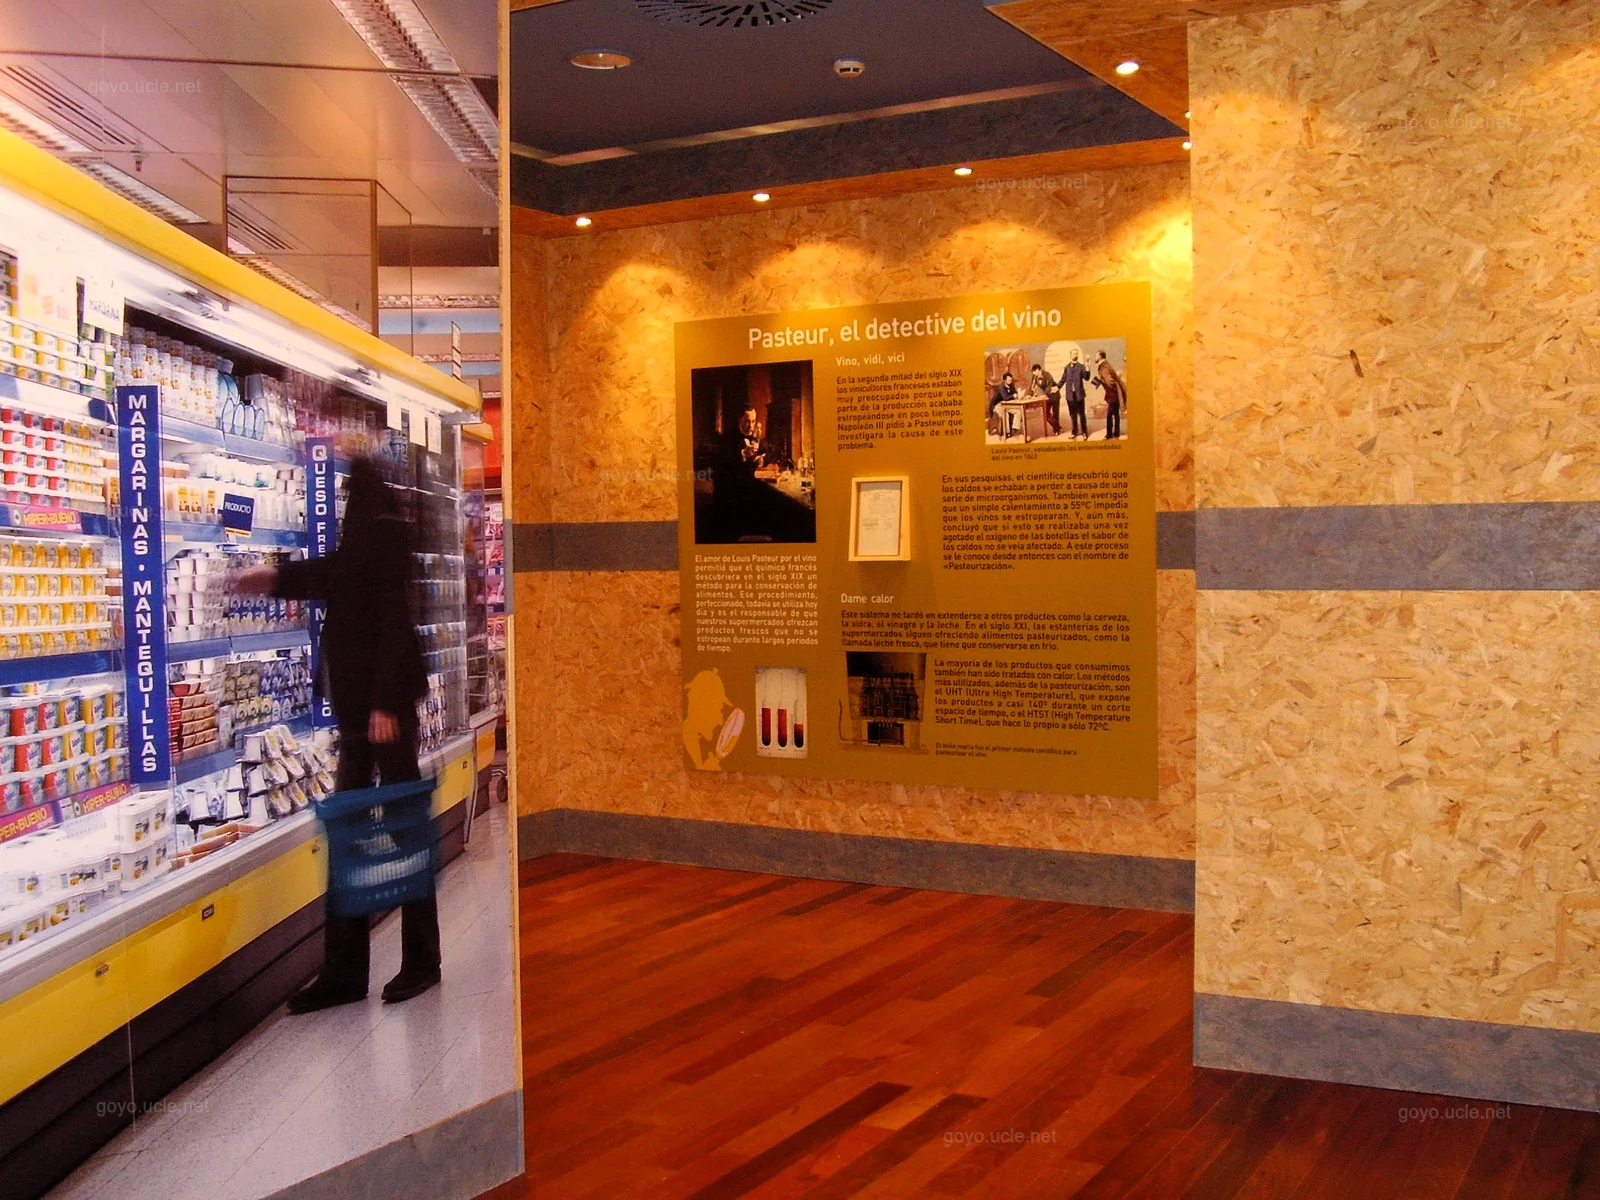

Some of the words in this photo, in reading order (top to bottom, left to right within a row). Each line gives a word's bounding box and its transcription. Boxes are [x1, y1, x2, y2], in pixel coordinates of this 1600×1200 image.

[749, 326, 835, 349] Pasteur,
[840, 320, 860, 342] el
[865, 313, 965, 339] detective
[971, 308, 1006, 332] del
[1012, 305, 1061, 328] vino
[836, 356, 860, 366] Vino,
[864, 354, 884, 364] vidi,
[888, 352, 905, 362] vici
[837, 376, 847, 384] En
[848, 375, 856, 383] la
[857, 373, 890, 385] segunda
[891, 372, 913, 381] mitad
[914, 371, 927, 379] del
[928, 370, 948, 380] siglo
[949, 369, 962, 377] XIX
[849, 383, 892, 392] vinicultores
[893, 381, 931, 390] franceses
[932, 380, 962, 388] estaban
[837, 396, 854, 404] muy
[858, 391, 910, 403] preocupados
[914, 391, 943, 400] porque
[837, 404, 858, 414] parte
[860, 403, 870, 411] de
[929, 399, 962, 407] acababa
[910, 412, 929, 420] poco
[914, 419, 946, 427] Pasteur
[948, 420, 963, 428] que
[838, 431, 884, 442] investigara
[945, 428, 963, 436] este
[128, 395, 149, 555] MARGARINAS
[312, 445, 327, 516] QUESO
[942, 475, 953, 483] En
[1016, 473, 1024, 481] el
[1111, 472, 1128, 481] que
[942, 494, 963, 502] serie
[972, 504, 999, 513] simple
[1002, 503, 1061, 511] calentamiento
[1048, 522, 1089, 530] realizaba
[317, 522, 326, 557] FRE
[841, 594, 867, 603] Dame
[871, 594, 894, 603] calor
[134, 581, 157, 772] MANTEQUILLAS
